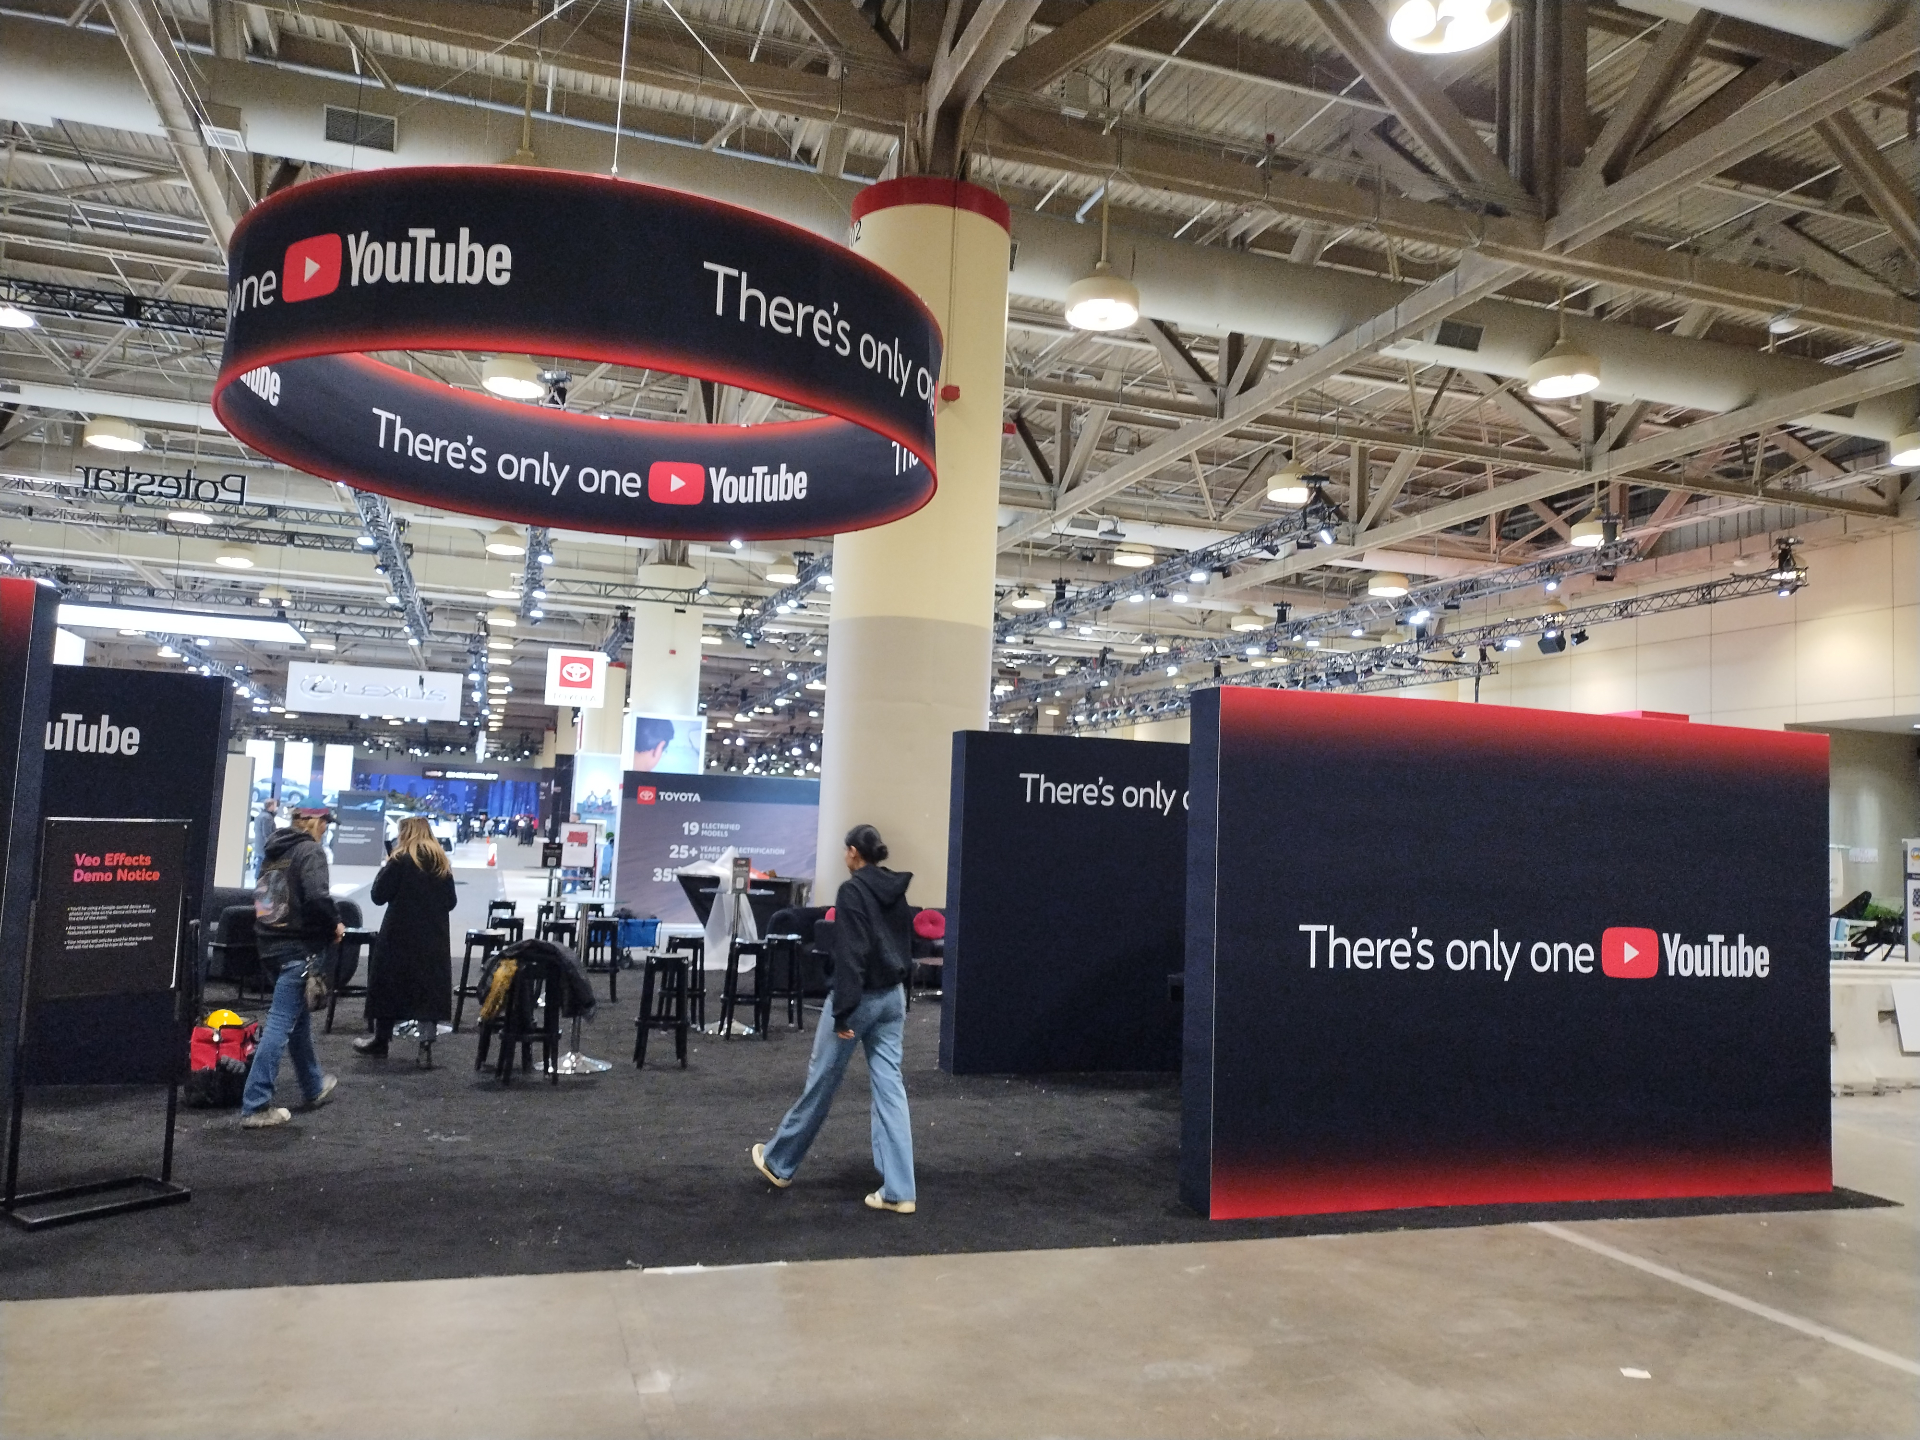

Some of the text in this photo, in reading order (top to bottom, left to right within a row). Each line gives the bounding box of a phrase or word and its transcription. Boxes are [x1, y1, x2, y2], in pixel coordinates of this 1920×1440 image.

[347, 227, 512, 287] YouTube
[703, 261, 850, 356] There's
[859, 337, 912, 398] only
[372, 407, 808, 504] There's only one YouTube
[659, 791, 701, 802] TOYOTA
[1019, 772, 1115, 807] There's
[1122, 780, 1177, 816] only
[682, 821, 700, 836] 19
[701, 822, 741, 831] ELECTRIFIED
[701, 830, 729, 838] MODELS
[669, 844, 698, 859] 25+
[700, 845, 721, 853] YEARS
[74, 852, 152, 867] Veo Effects
[73, 868, 161, 883] Demo Notice
[1298, 924, 1770, 982] There's only one YouTube
